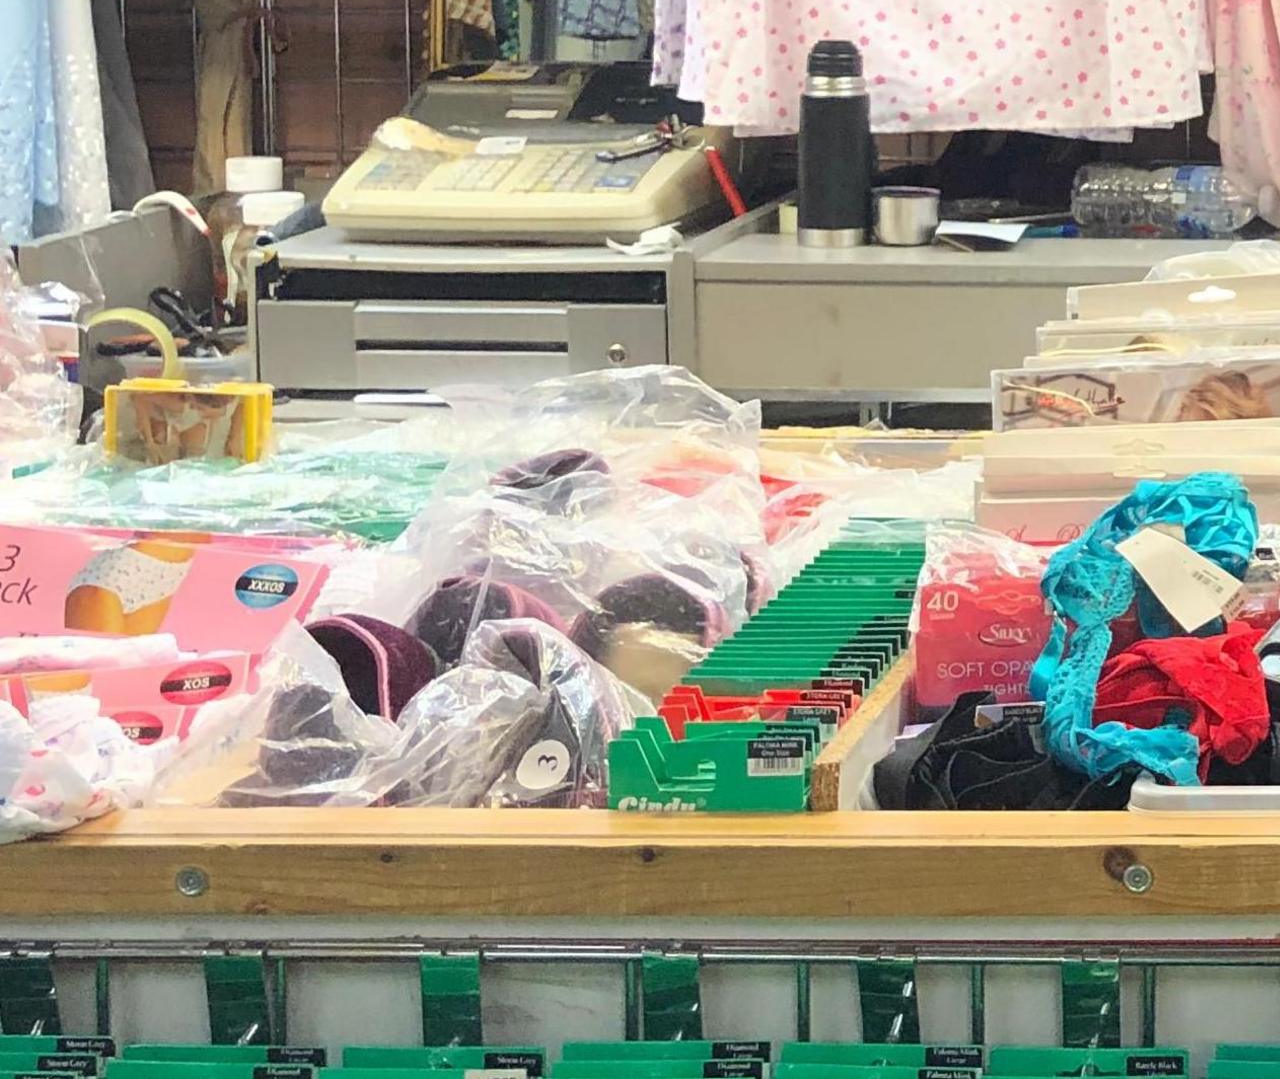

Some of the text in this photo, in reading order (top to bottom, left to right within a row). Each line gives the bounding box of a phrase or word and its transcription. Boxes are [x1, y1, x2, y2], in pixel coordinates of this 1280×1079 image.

[0, 545, 21, 572] 3
[0, 578, 37, 605] ck
[927, 591, 959, 611] 40
[937, 660, 1036, 678] SOFT OPA
[121, 726, 141, 739] OS
